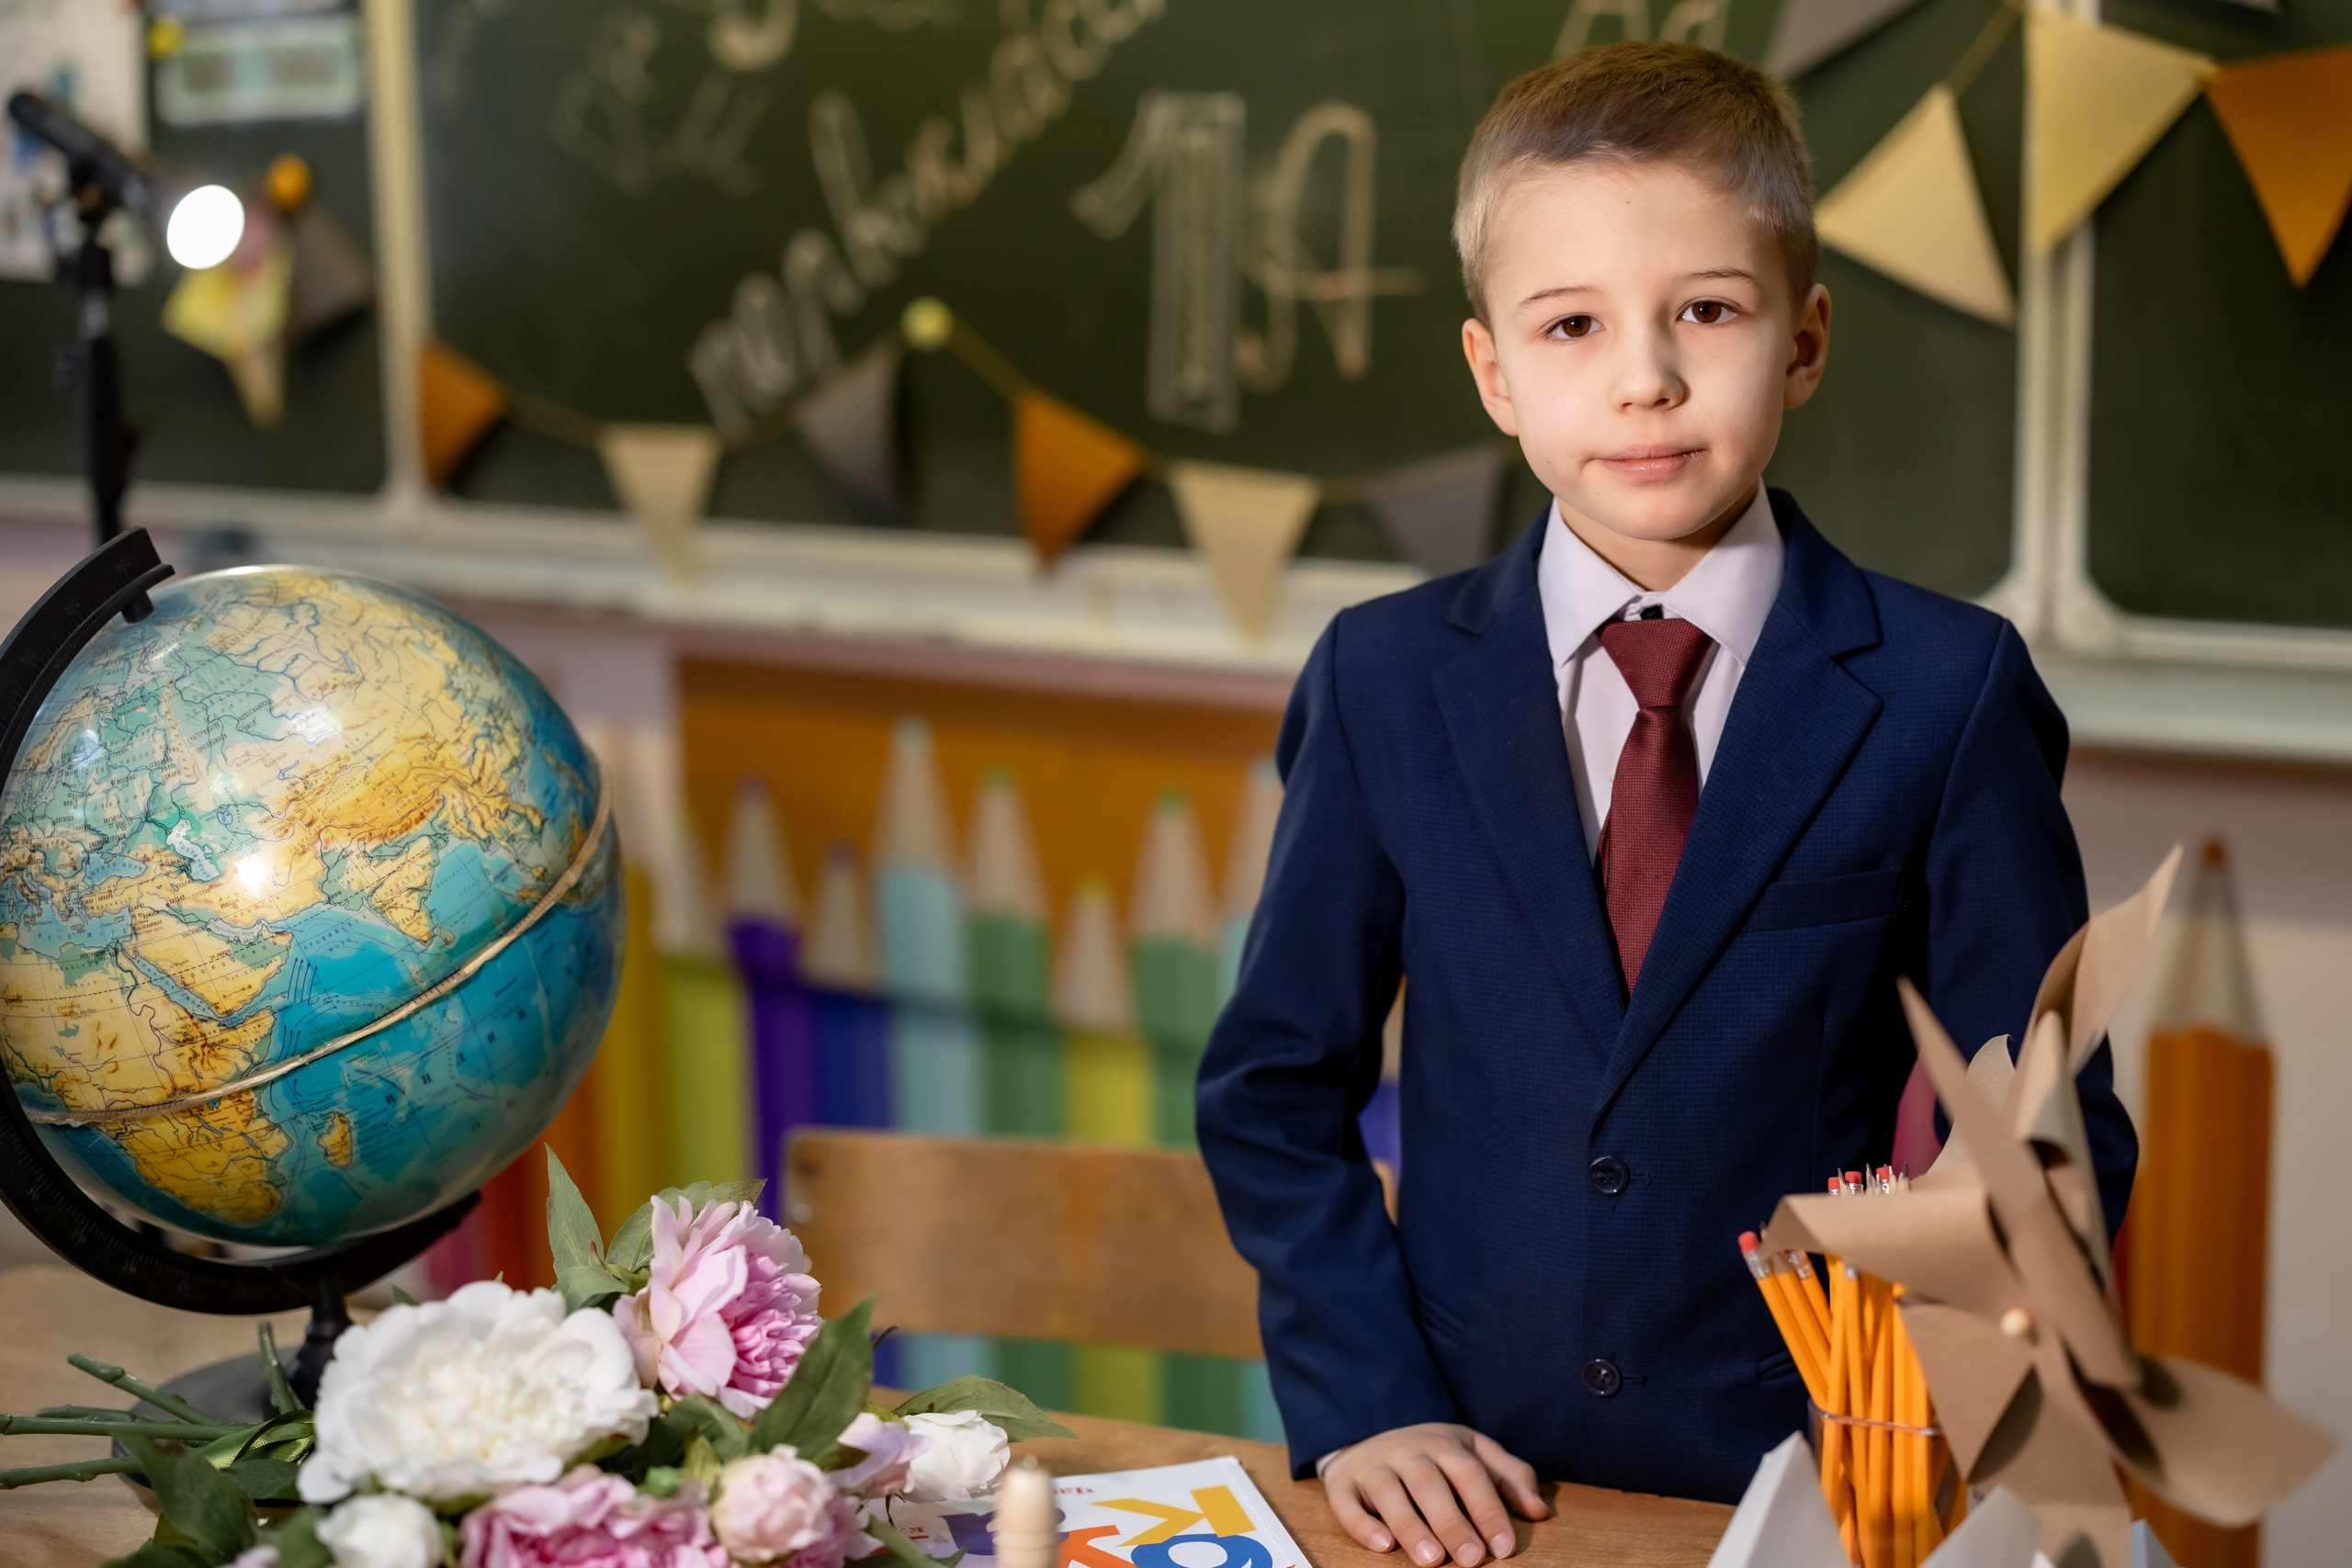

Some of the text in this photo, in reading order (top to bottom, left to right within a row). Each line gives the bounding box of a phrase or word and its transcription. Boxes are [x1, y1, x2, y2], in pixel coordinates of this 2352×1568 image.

[116, 773, 136, 785] МОСКВА
[161, 770, 180, 781] САМАРА
[121, 861, 143, 873] МОРЕ
[86, 926, 128, 938] МОРЕ
[303, 913, 368, 951] АРАВИЙСКОЕ
[328, 936, 352, 953] МОРЕ
